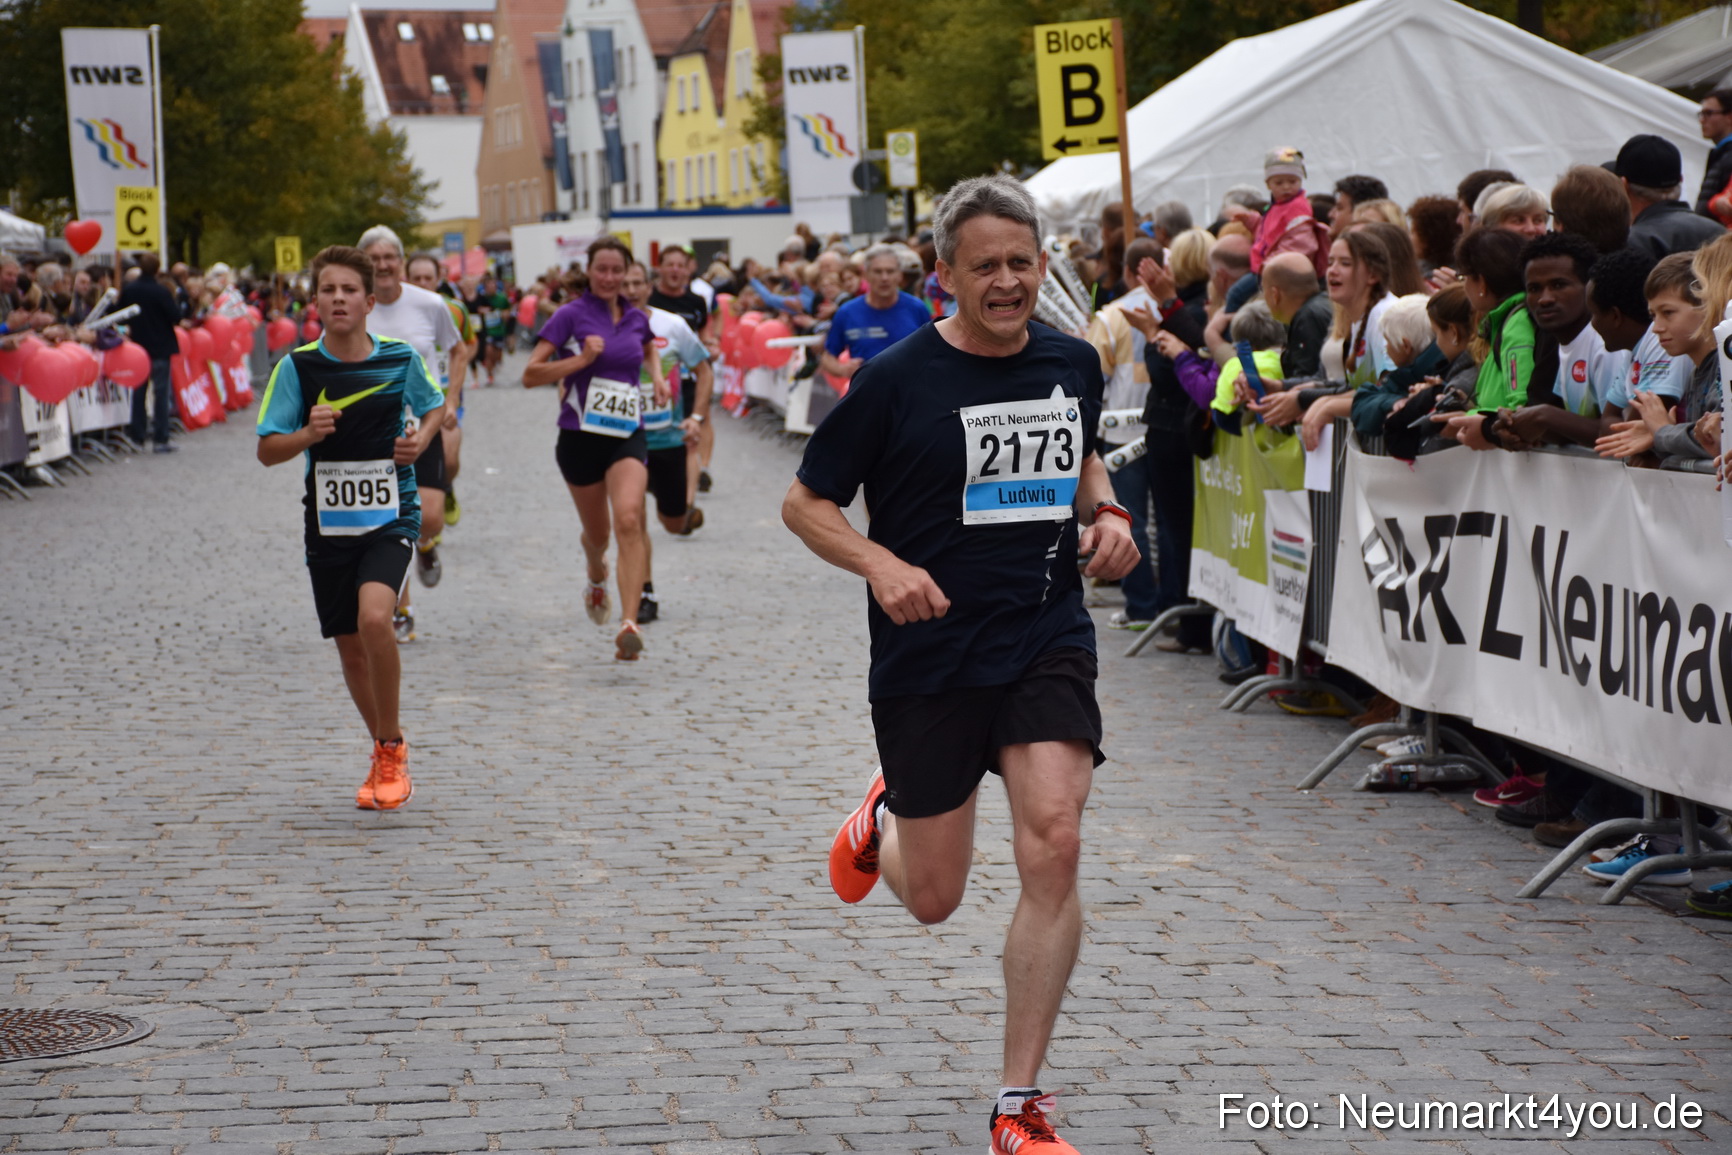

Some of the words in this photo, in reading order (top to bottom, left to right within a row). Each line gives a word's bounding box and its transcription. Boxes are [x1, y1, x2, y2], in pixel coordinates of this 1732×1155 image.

[1046, 27, 1113, 54] Block
[1061, 63, 1105, 128] B
[119, 188, 153, 201] Block
[126, 206, 148, 236] C
[593, 391, 636, 417] 2445
[966, 415, 1005, 428] PARTL
[1008, 411, 1062, 425] Neumarkt
[980, 428, 1074, 477] 2173
[317, 468, 342, 476] PARTL
[344, 468, 382, 476] Neumarkt
[325, 478, 391, 507] 3095
[998, 486, 1056, 505] Ludwig
